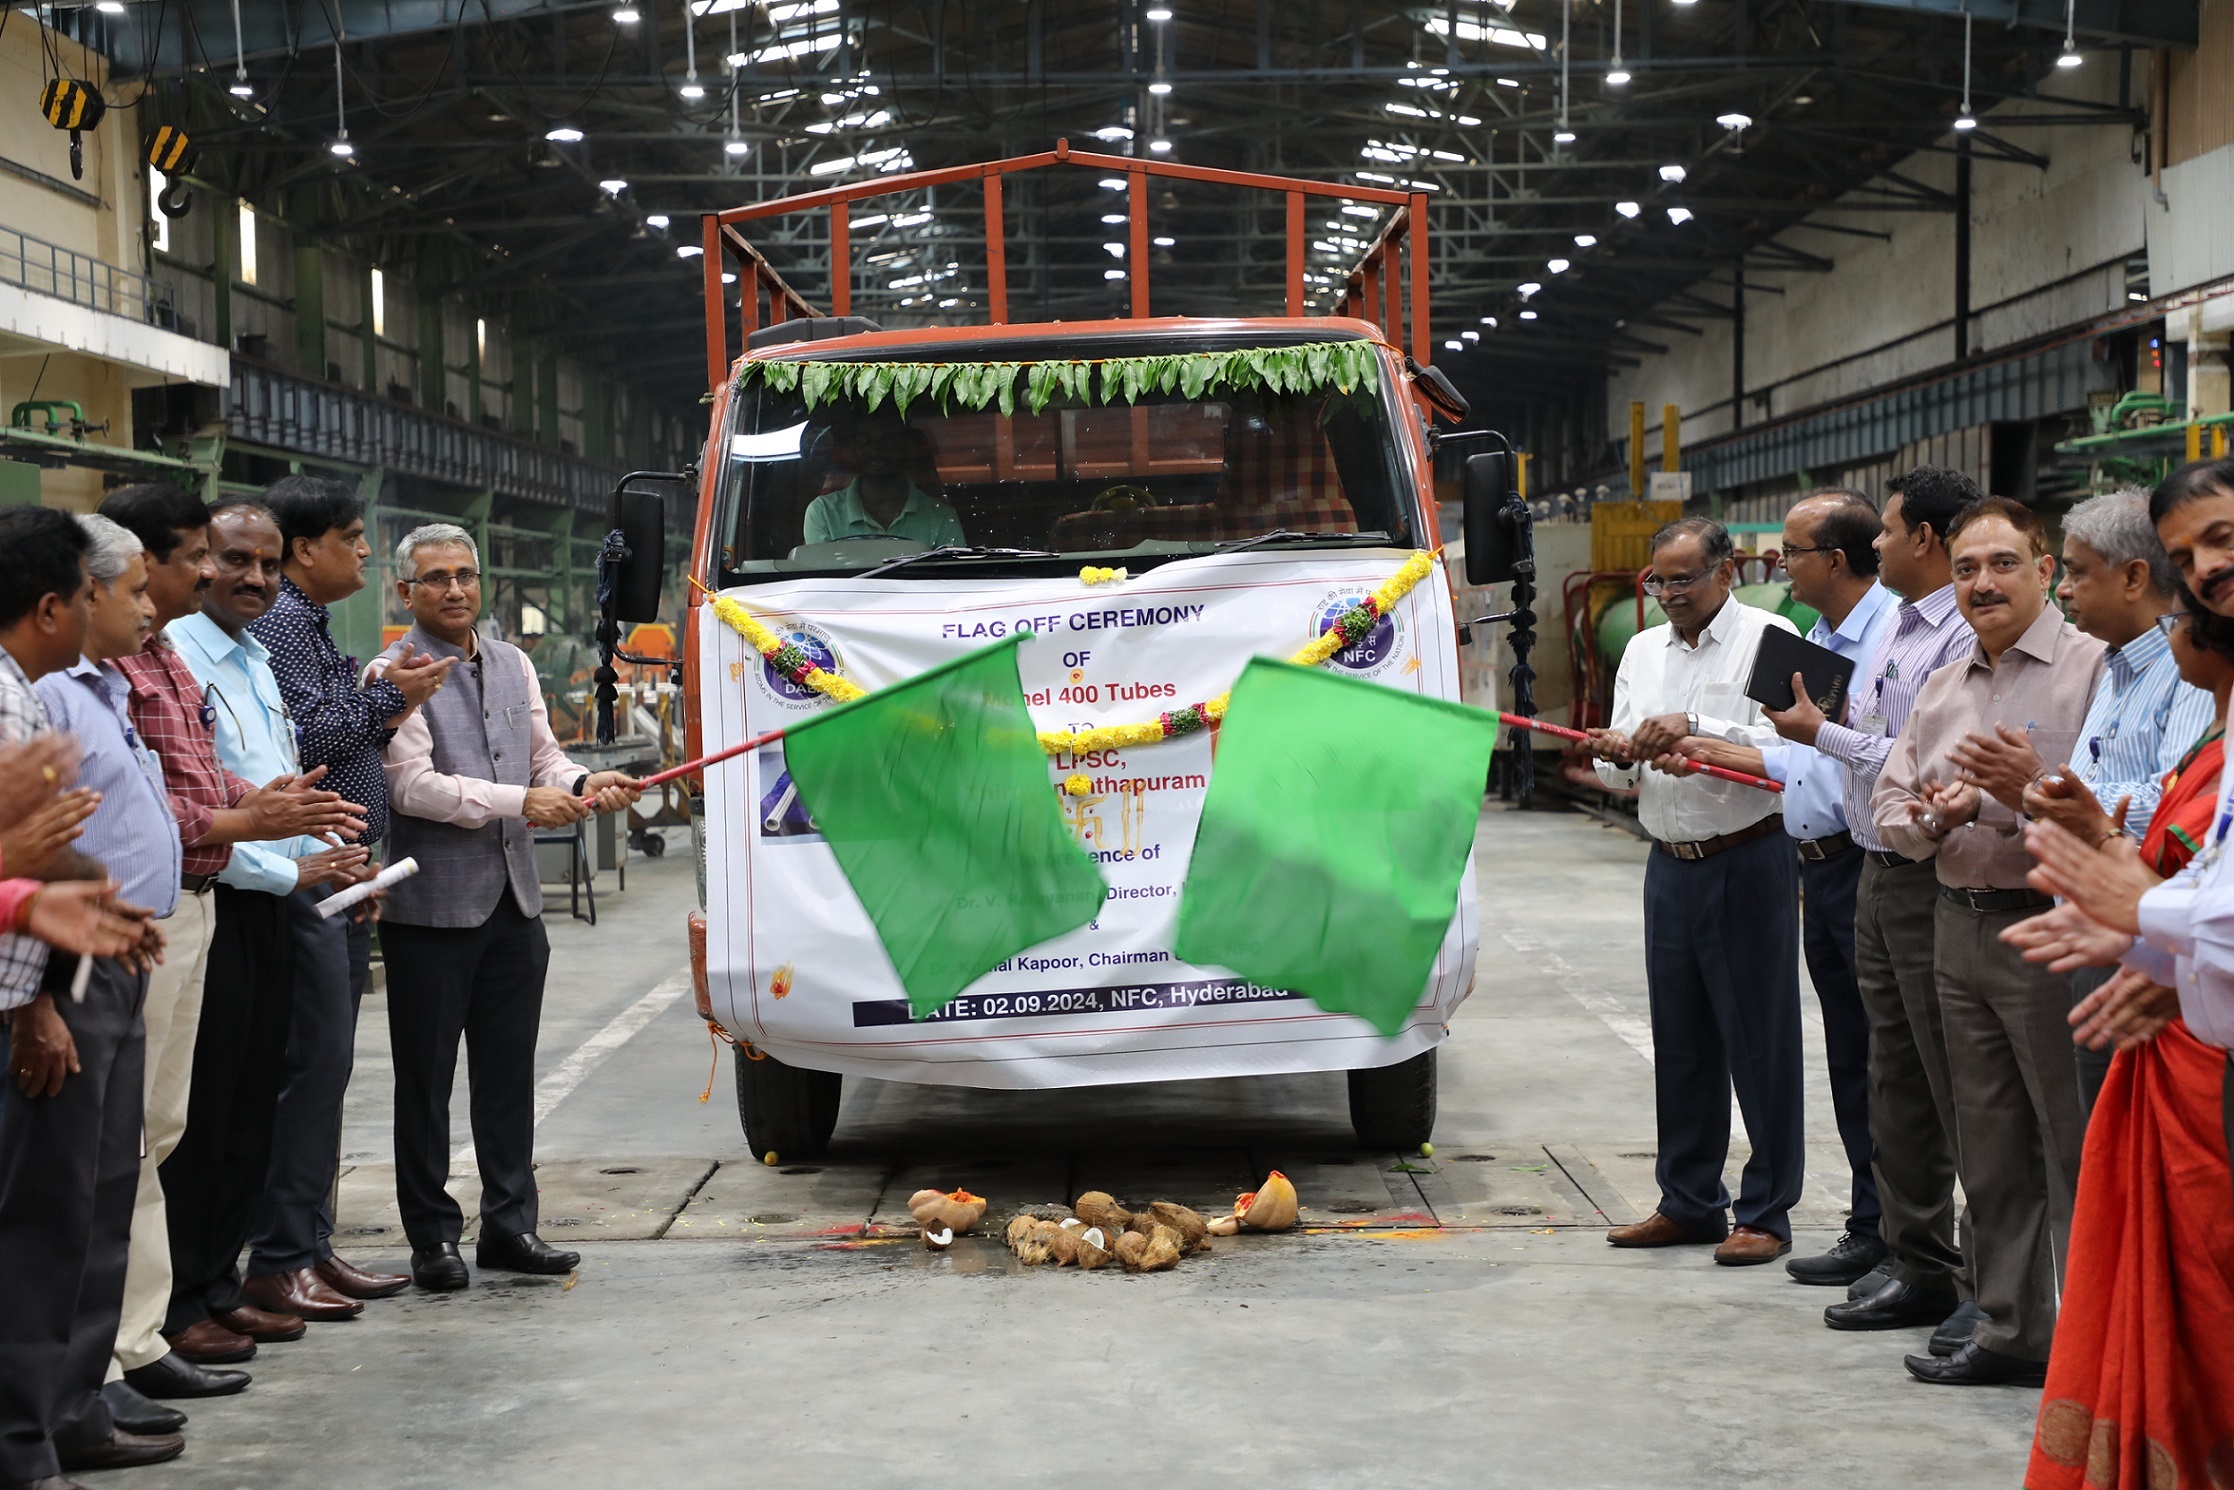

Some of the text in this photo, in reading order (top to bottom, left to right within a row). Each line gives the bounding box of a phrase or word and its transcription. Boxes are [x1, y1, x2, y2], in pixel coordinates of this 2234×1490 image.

[942, 604, 1205, 639] FLAG OFF CEREMONY
[1062, 651, 1091, 668] OF
[1343, 649, 1376, 663] NFC
[1373, 667, 1383, 677] OF
[1382, 659, 1395, 671] THE
[1392, 635, 1405, 661] NATION
[754, 672, 767, 694] ATOMS
[766, 692, 774, 701] IN
[773, 697, 785, 708] THE
[786, 701, 812, 711] SERVICE
[1058, 685, 1099, 704] 400
[1105, 681, 1177, 702] Tubes
[1141, 844, 1161, 861] of
[1106, 884, 1177, 901] Director,
[1089, 919, 1100, 931] &
[1017, 953, 1084, 974] Kapoor,
[1088, 948, 1169, 967] Chairman
[983, 992, 1104, 1016] 02.09.2024,
[1111, 987, 1163, 1009] NFC,
